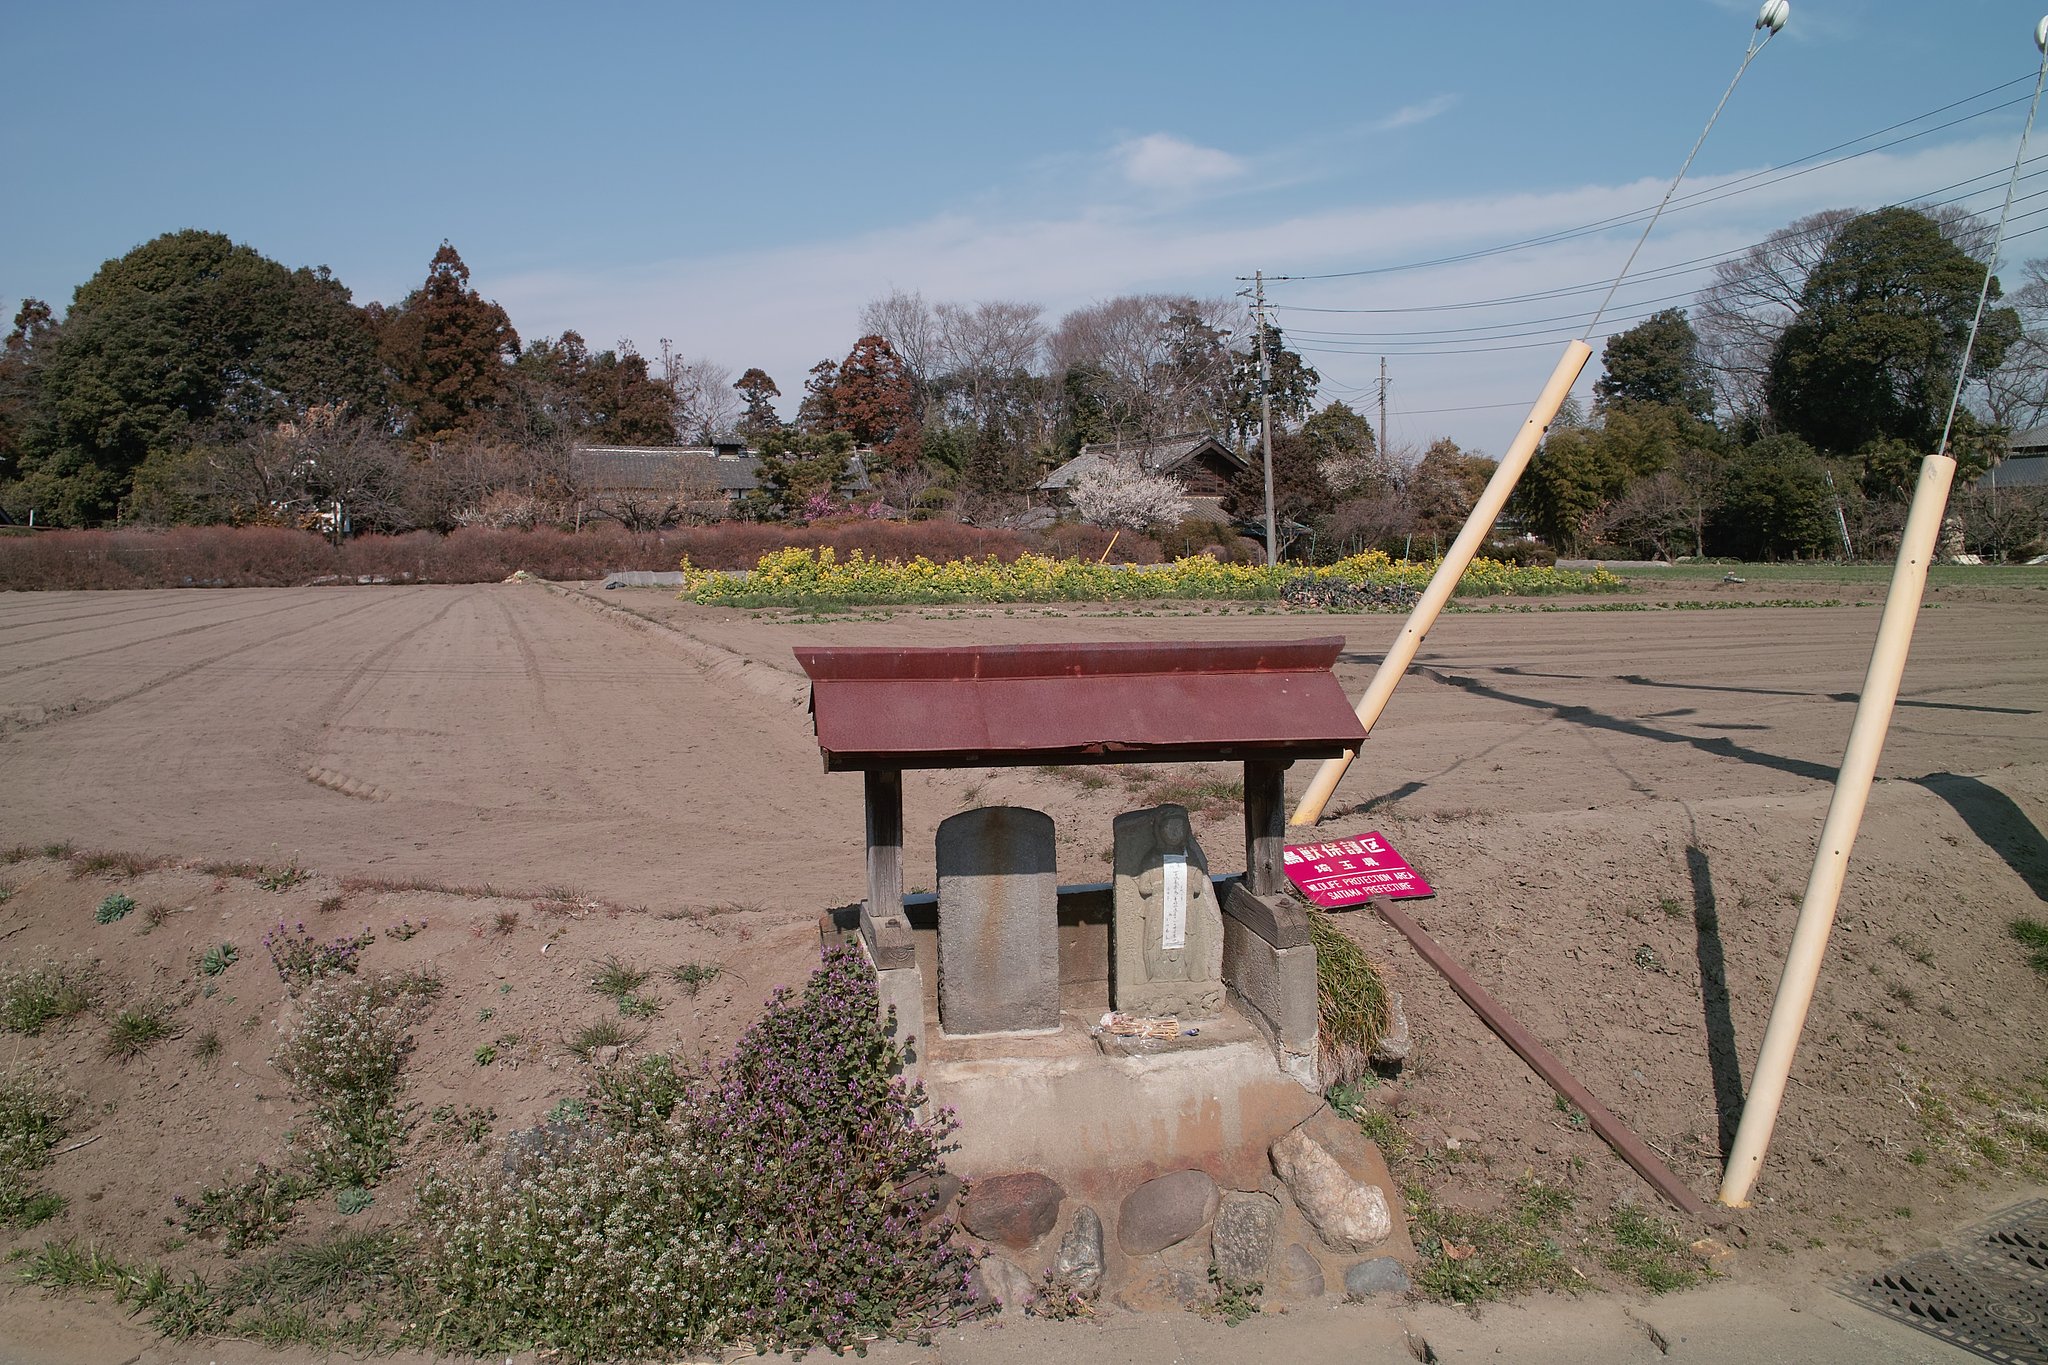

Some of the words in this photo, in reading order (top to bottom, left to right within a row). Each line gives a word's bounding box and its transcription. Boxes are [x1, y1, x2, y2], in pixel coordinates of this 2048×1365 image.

[1314, 857, 1380, 874] 埼玉県
[1343, 873, 1391, 887] PROTECTION
[1395, 871, 1415, 881] AREA
[1327, 888, 1363, 901] SAITAMA
[1363, 881, 1415, 895] PREFECTURE
